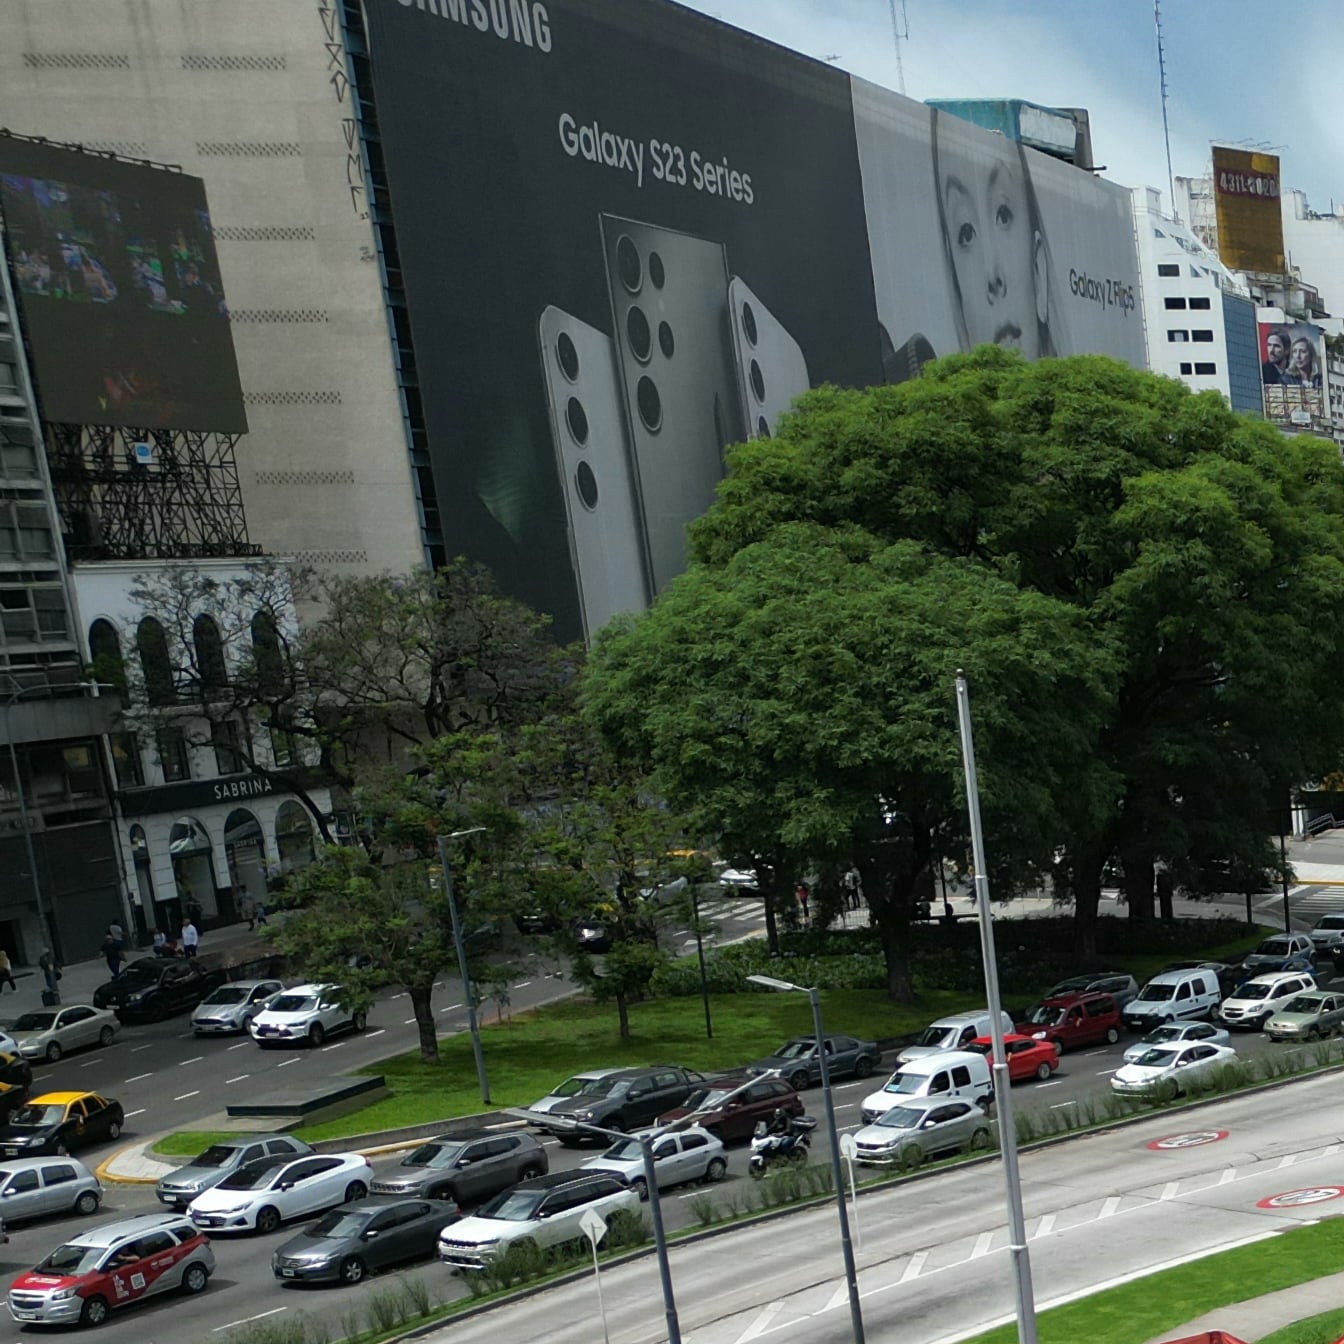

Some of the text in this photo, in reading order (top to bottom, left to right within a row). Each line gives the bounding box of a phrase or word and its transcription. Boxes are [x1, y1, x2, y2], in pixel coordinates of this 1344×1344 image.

[558, 112, 754, 204] Galaxy S23 Series
[1069, 268, 1134, 317] Galaxy Z Flip5
[214, 778, 272, 799] SABRINA
